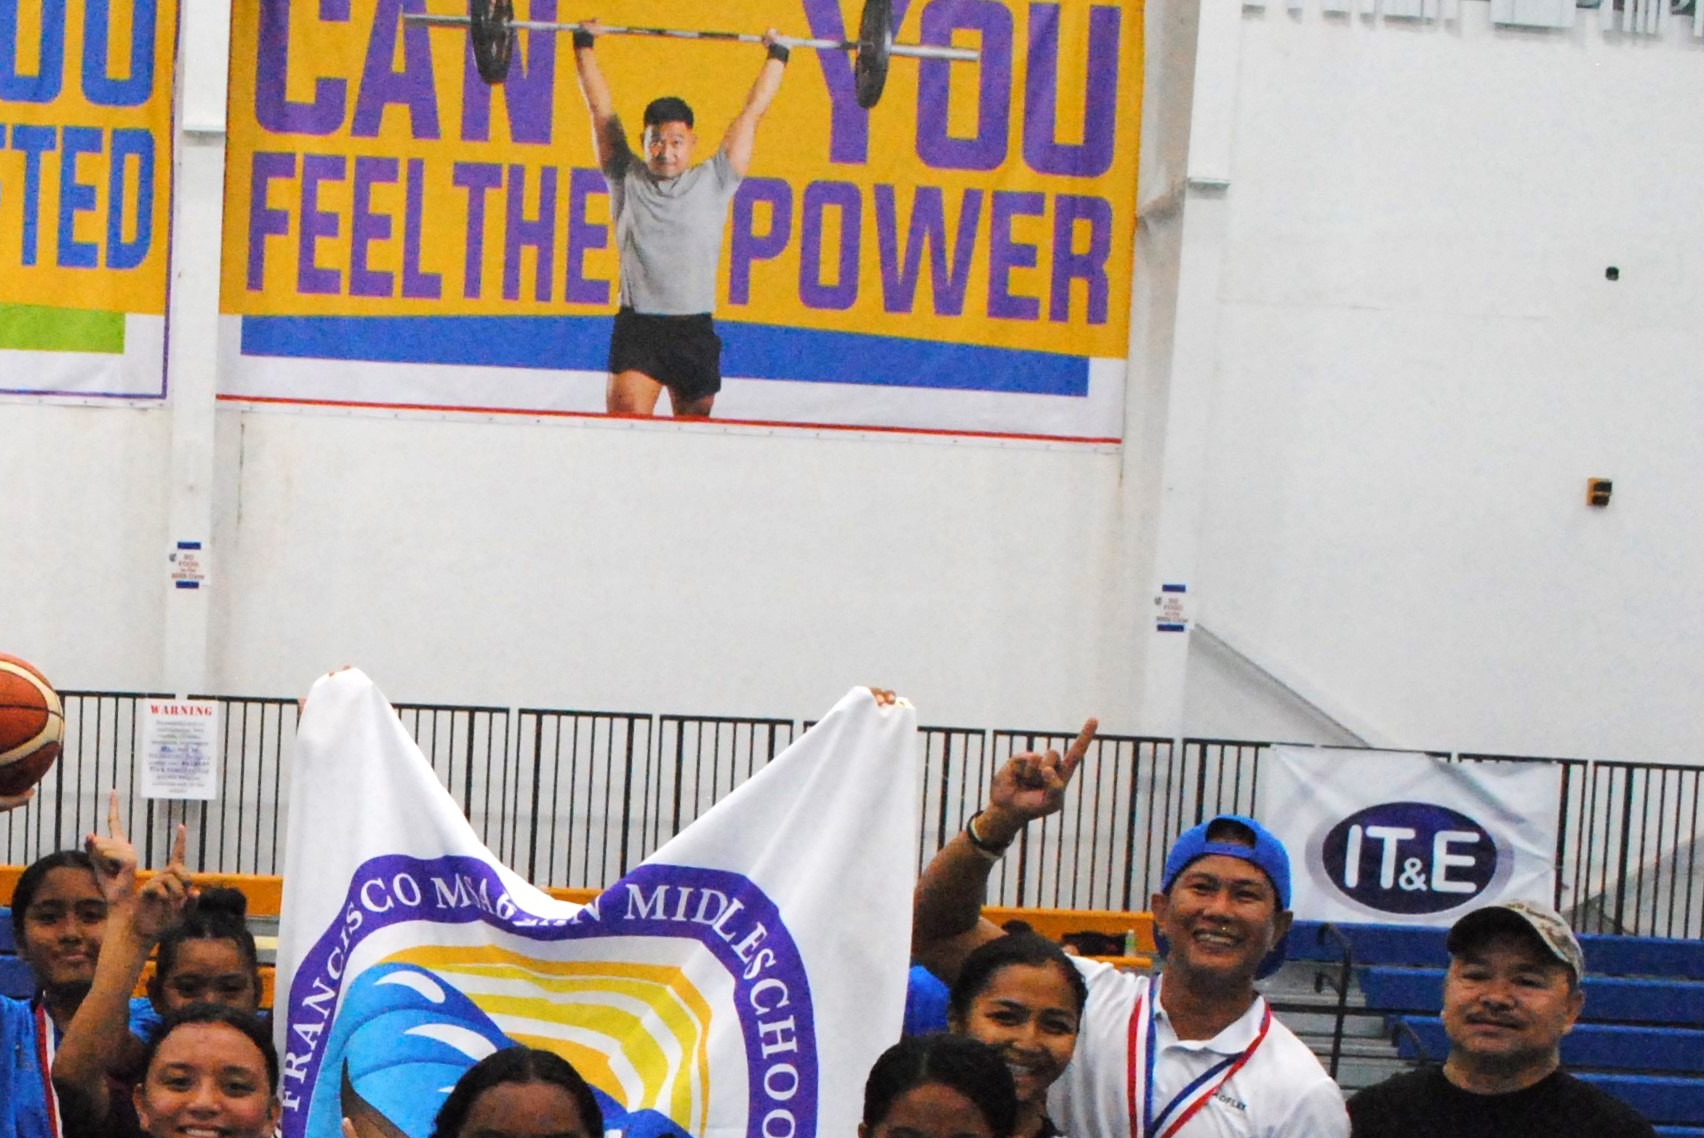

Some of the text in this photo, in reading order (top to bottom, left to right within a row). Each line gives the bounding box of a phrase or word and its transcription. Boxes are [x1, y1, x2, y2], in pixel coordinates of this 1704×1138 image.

[256, 0, 1119, 177] CAN YOU
[247, 154, 1111, 324] FEEL THE POWER
[150, 704, 213, 716] WARNING
[1345, 823, 1481, 893] IT&E
[282, 872, 422, 1112] FRANCISCO
